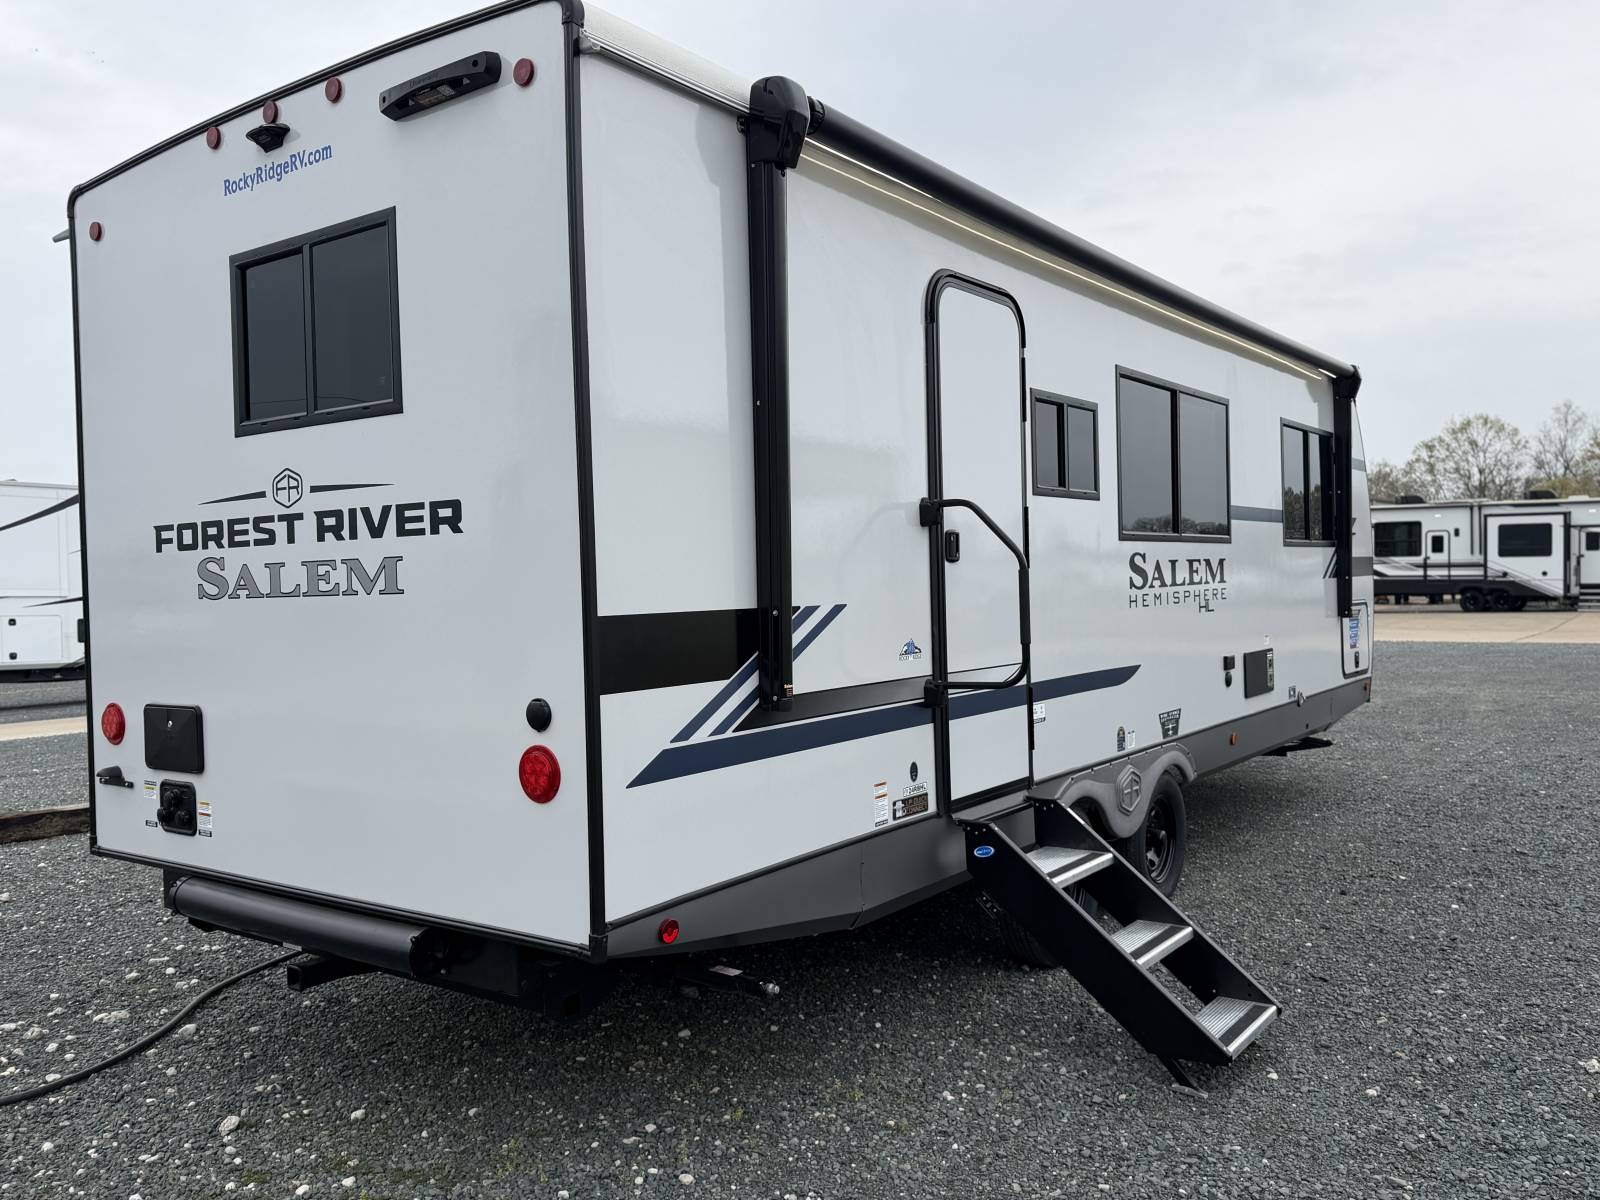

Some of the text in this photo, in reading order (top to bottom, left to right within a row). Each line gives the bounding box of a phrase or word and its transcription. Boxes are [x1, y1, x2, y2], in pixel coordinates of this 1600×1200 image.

[223, 144, 332, 196] RockyRidgeRV.com
[153, 499, 464, 553] FOREST RIVER
[197, 556, 404, 600] SALEM
[1128, 552, 1227, 590] SALEM
[1129, 588, 1227, 608] HEMISPHERE
